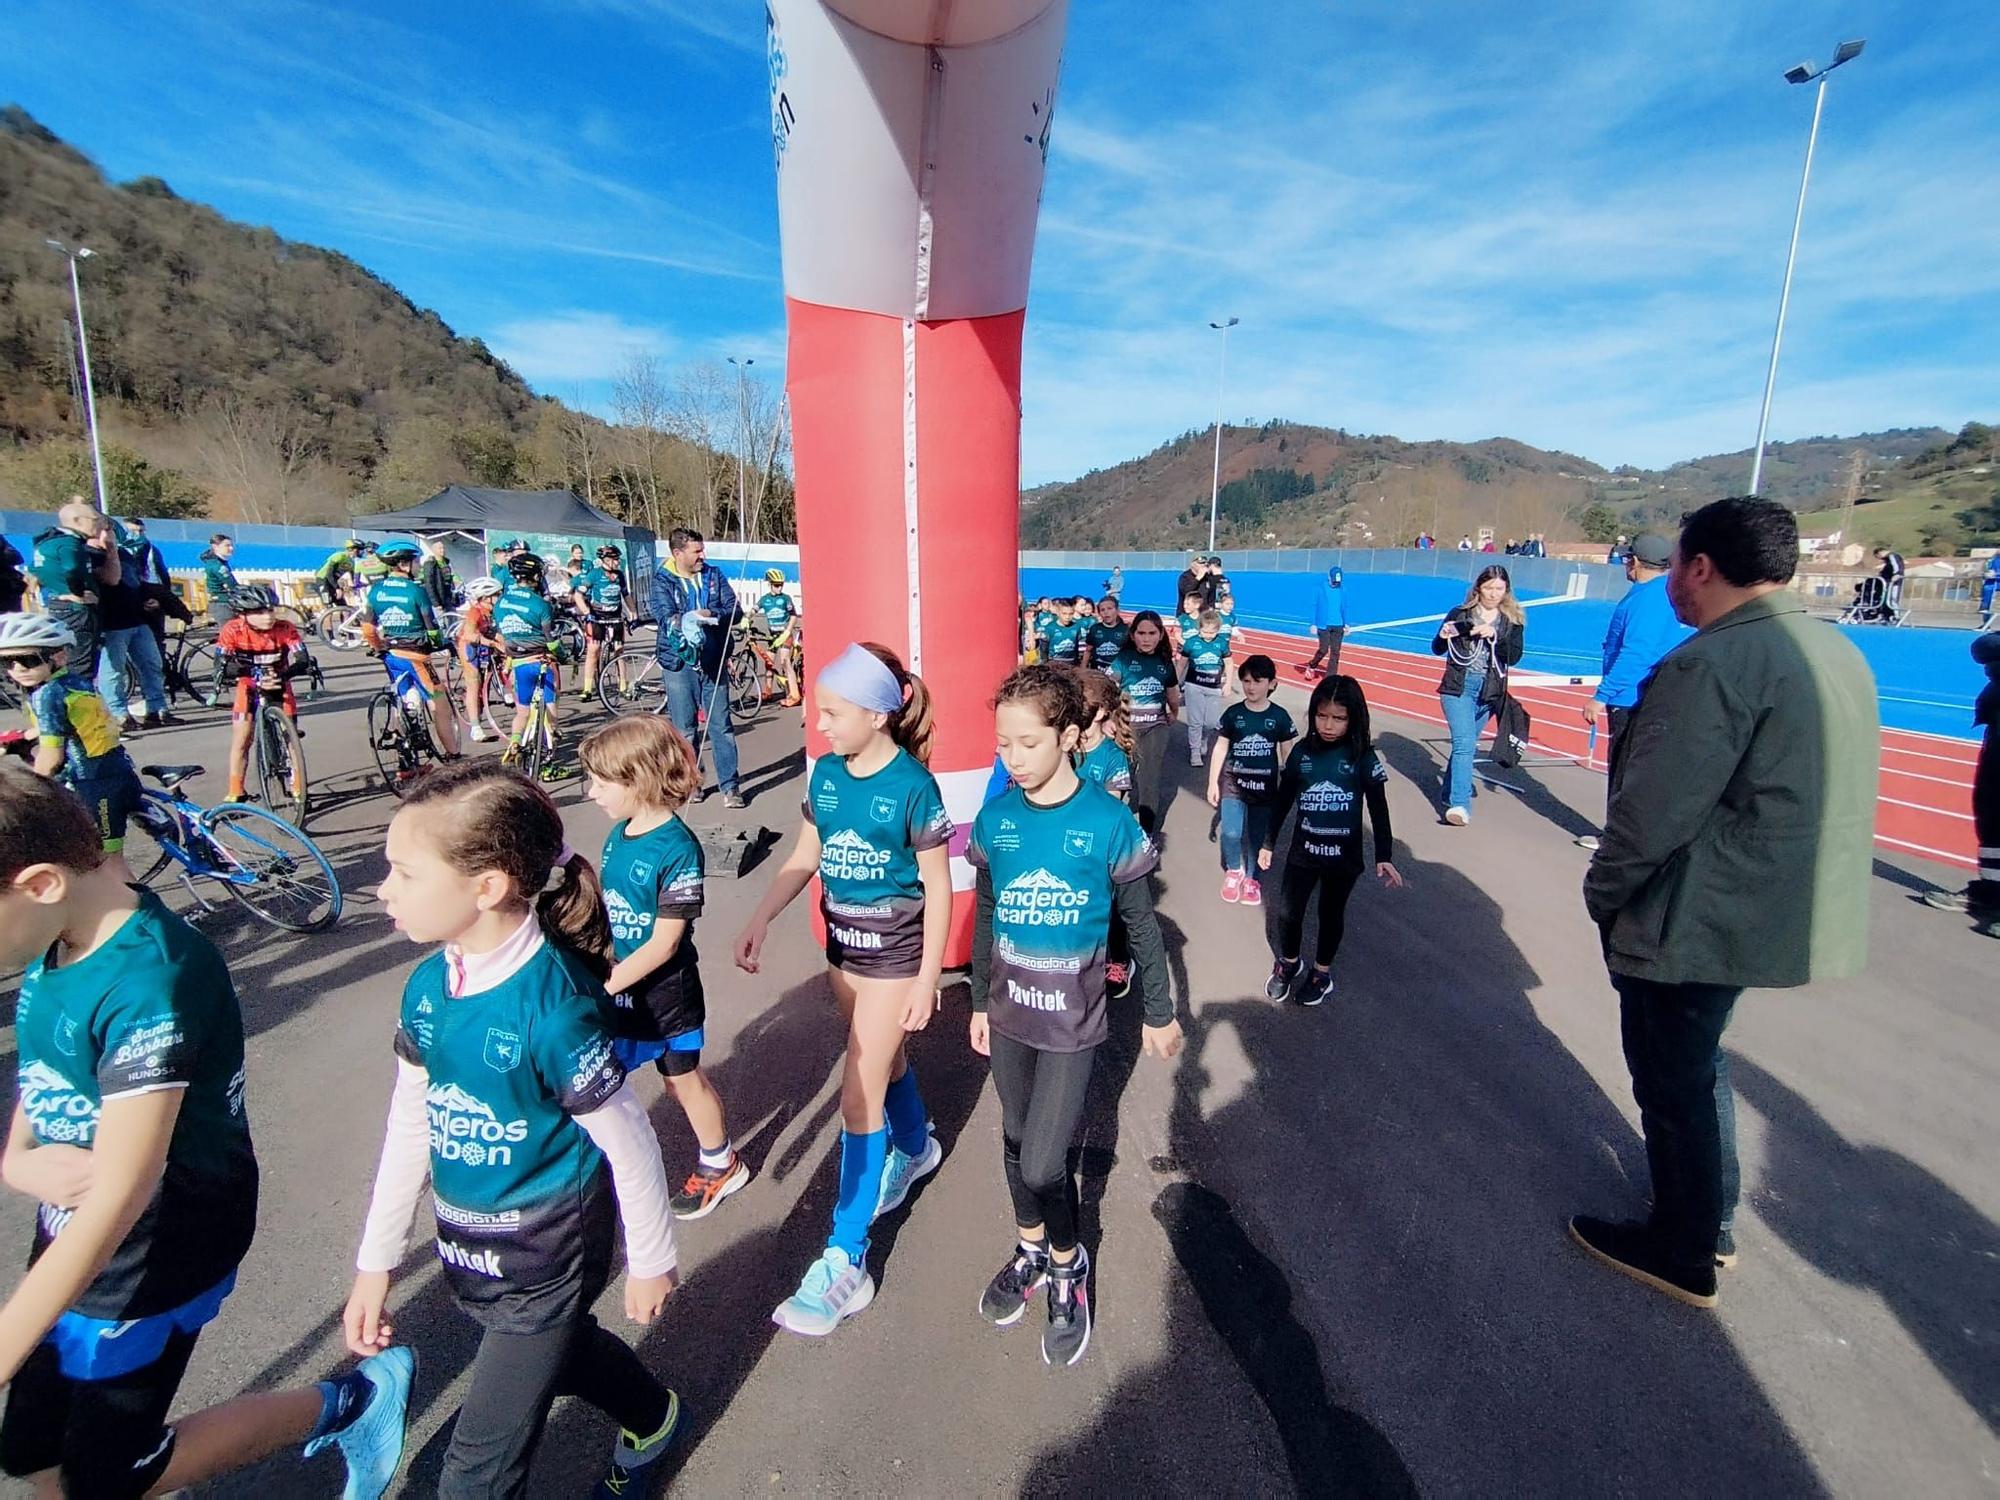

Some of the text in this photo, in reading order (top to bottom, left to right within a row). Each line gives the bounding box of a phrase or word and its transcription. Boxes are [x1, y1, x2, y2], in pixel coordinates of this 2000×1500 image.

[1007, 979, 1068, 1012] Pavitek
[131, 1021, 175, 1047] Santa
[128, 1066, 176, 1082] HUNOSA
